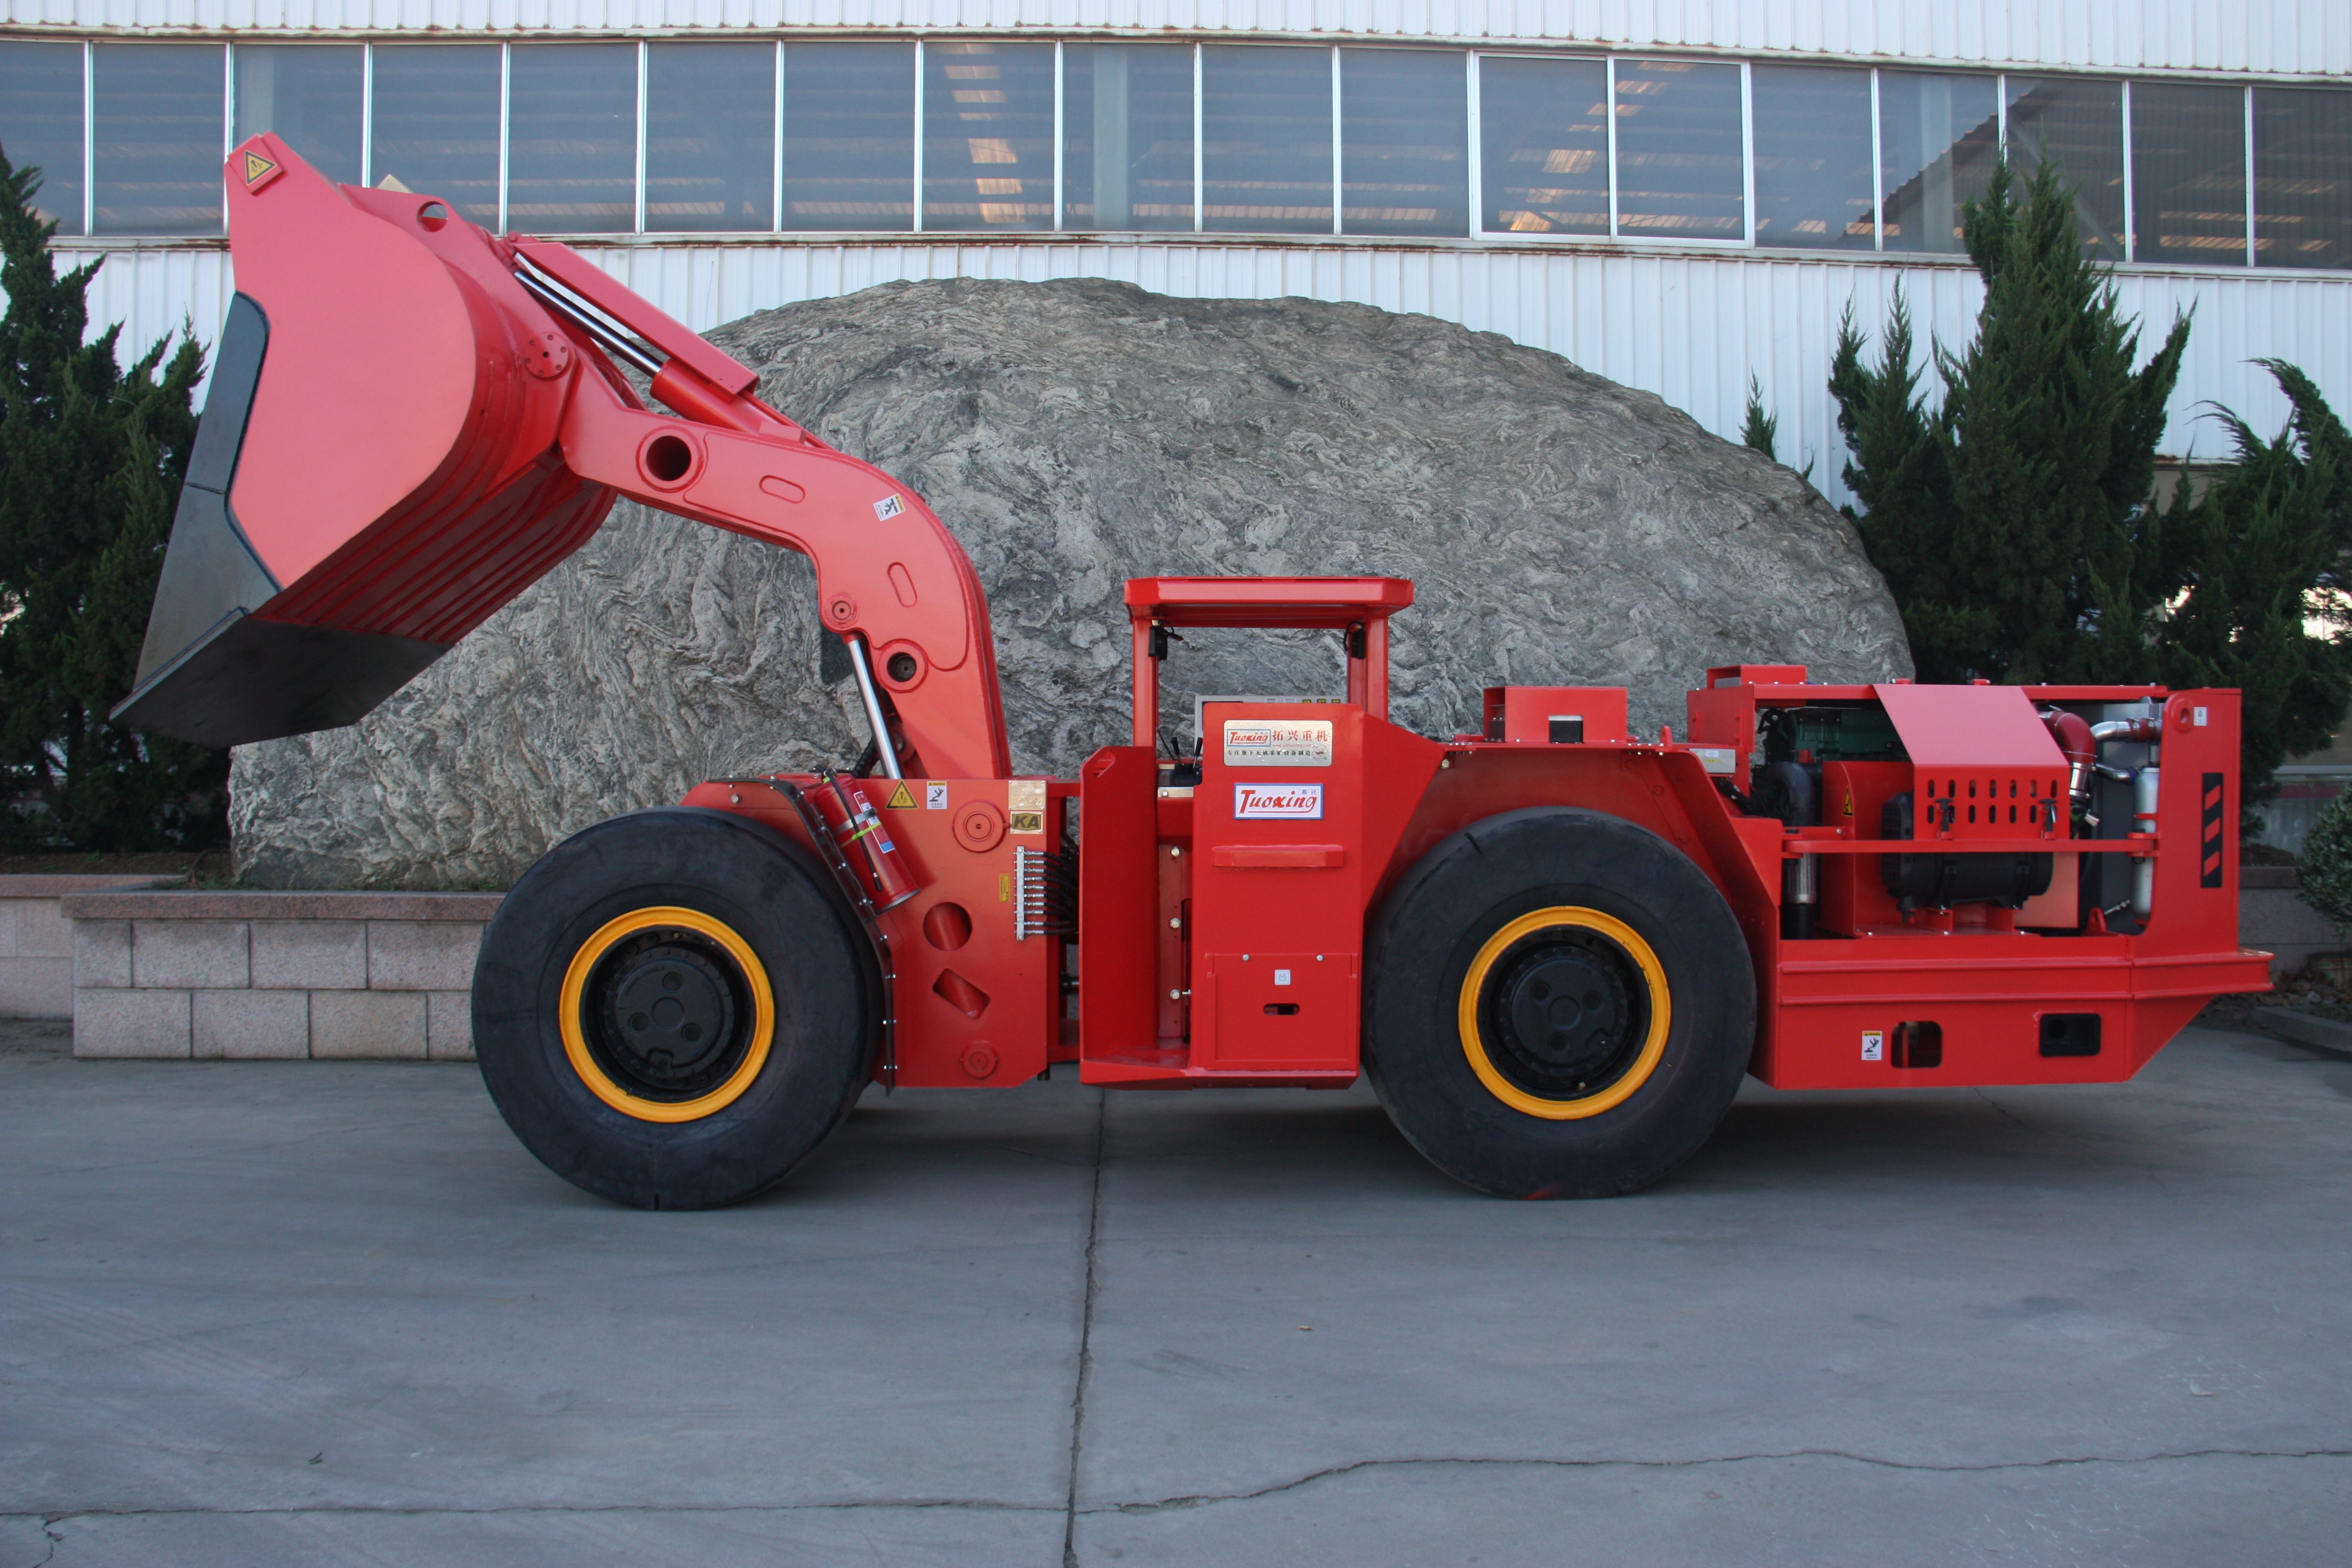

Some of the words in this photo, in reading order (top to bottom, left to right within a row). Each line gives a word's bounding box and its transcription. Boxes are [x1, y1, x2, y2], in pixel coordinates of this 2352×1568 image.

[1272, 729, 1328, 742] 拓兴重机
[1239, 790, 1317, 814] Tuoxing
[1014, 815, 1039, 829] KA
